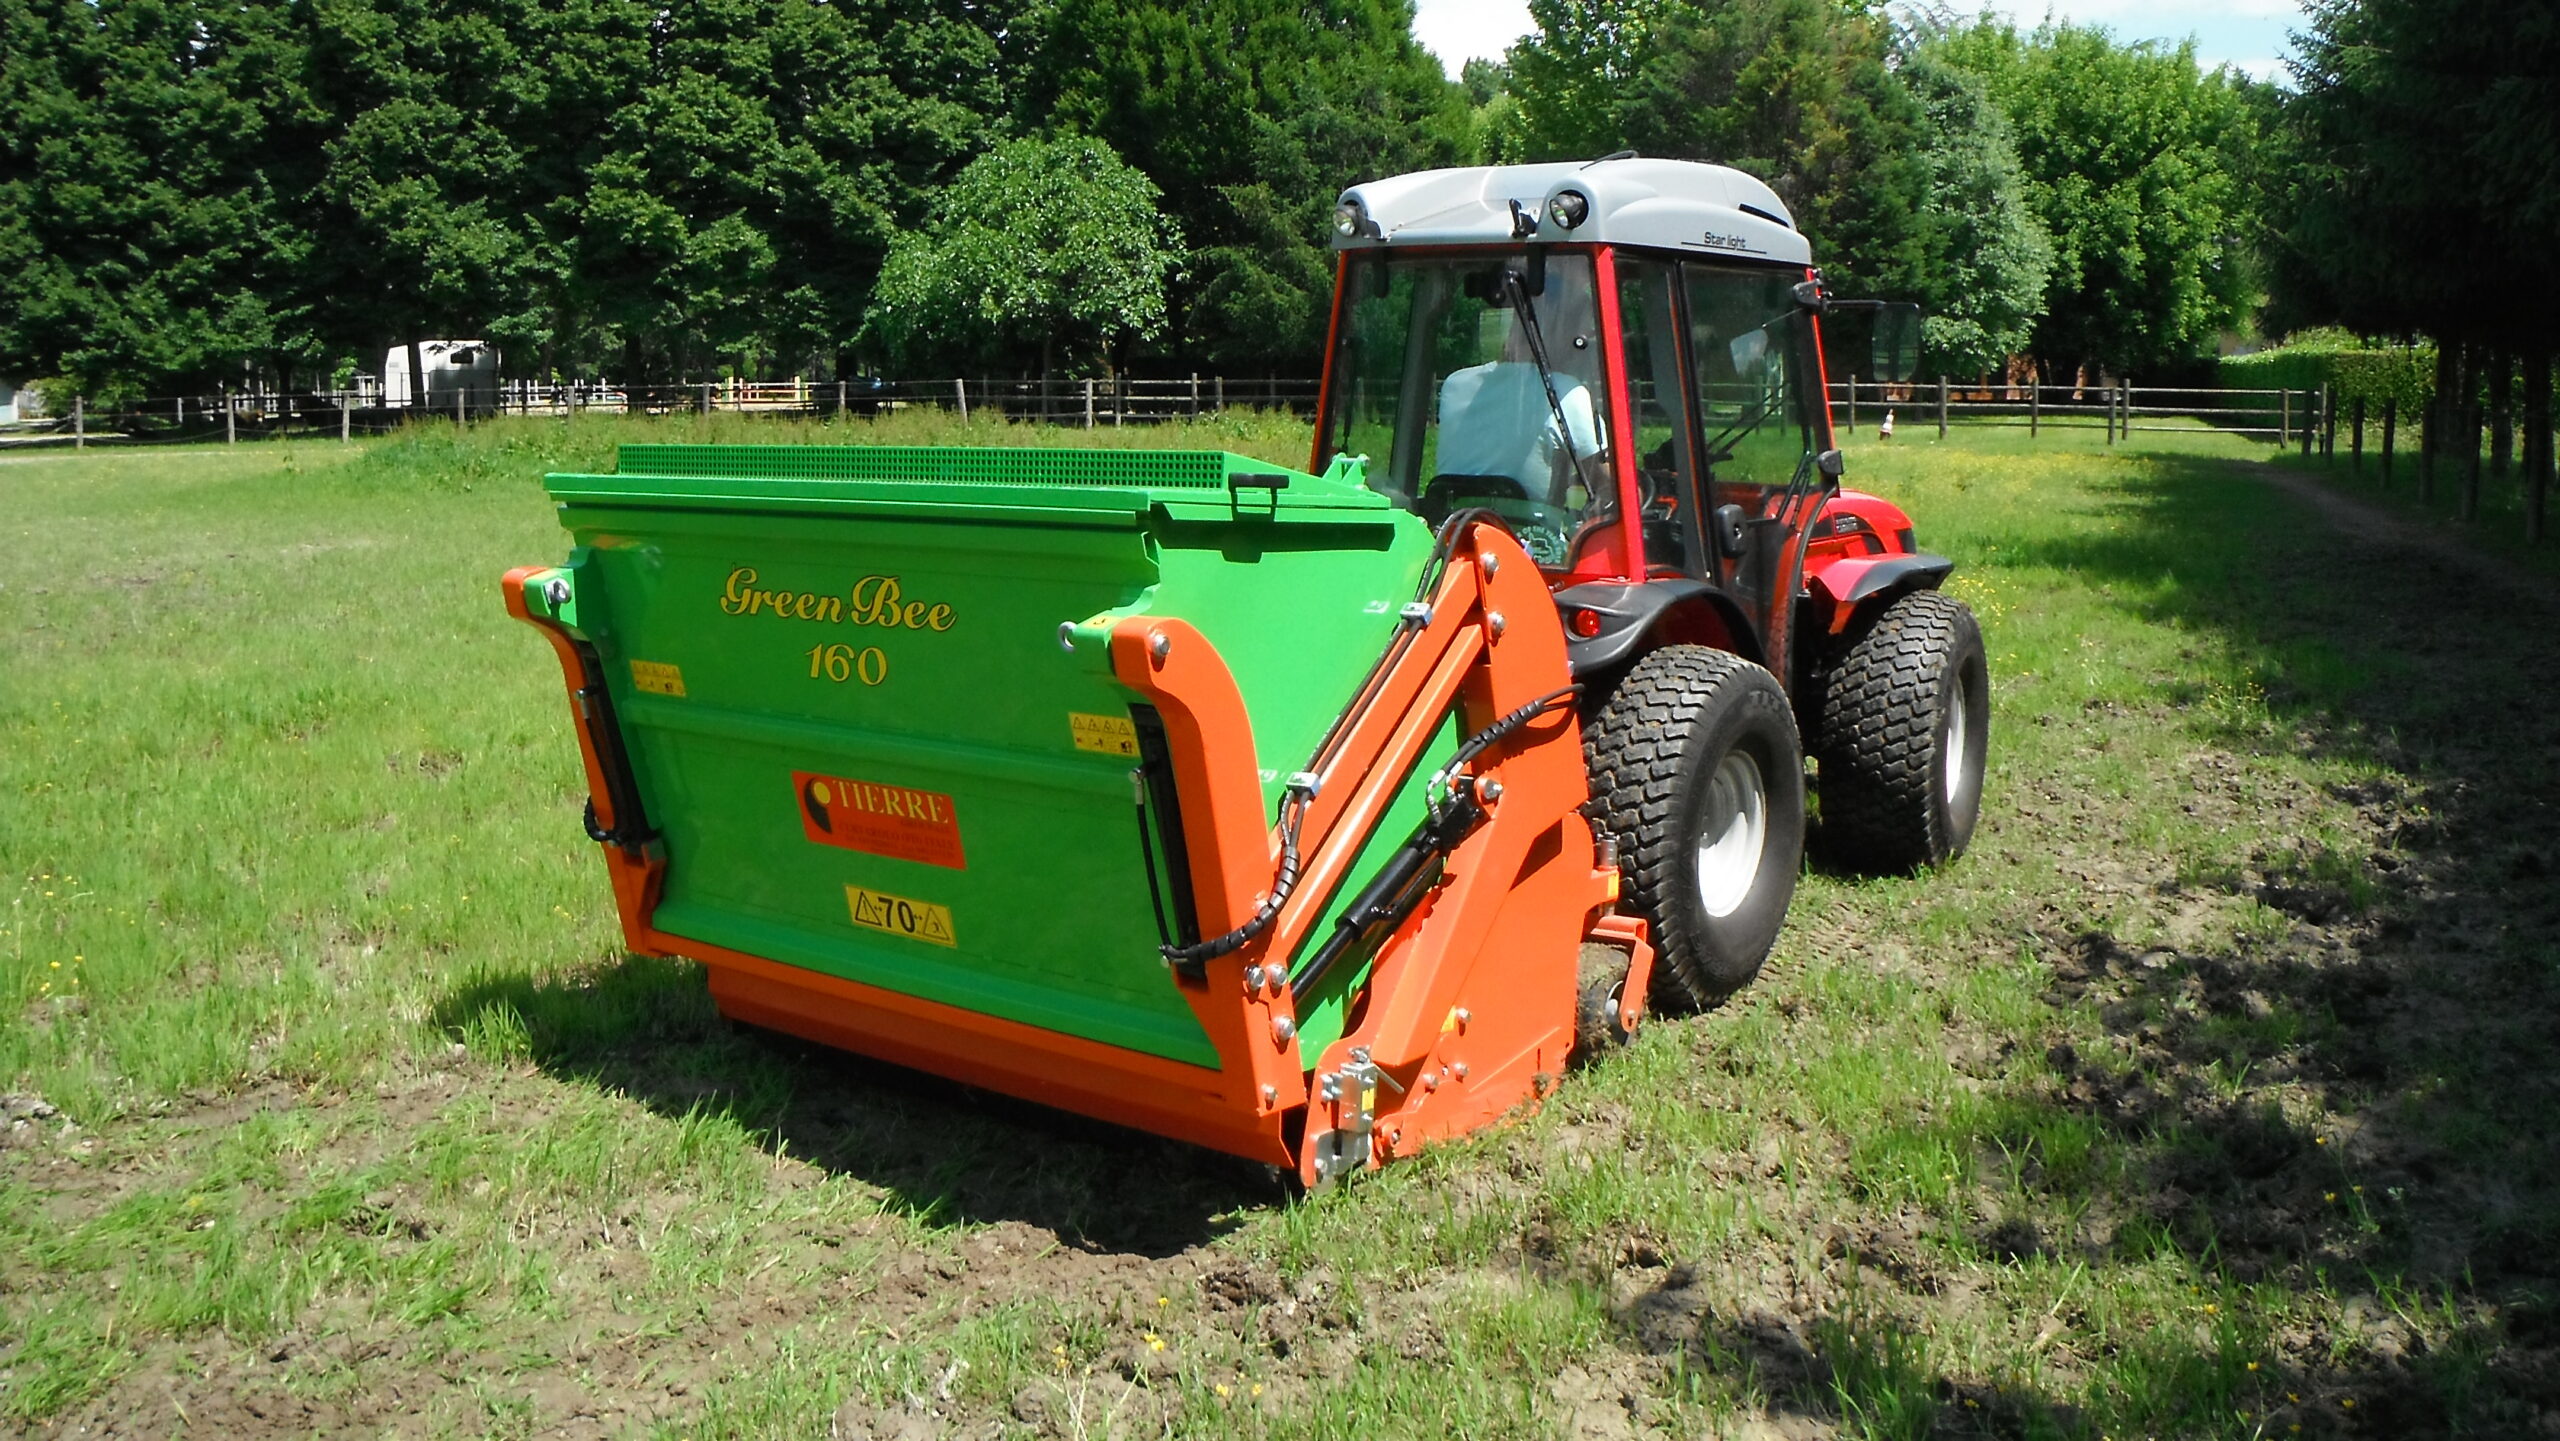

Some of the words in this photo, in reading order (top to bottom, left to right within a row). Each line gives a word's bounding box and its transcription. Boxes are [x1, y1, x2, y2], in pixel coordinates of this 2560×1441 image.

[1704, 231, 1725, 245] Star
[1727, 234, 1746, 251] light
[720, 566, 850, 623] Green
[851, 575, 957, 632] Bee
[805, 643, 888, 686] 160
[832, 780, 949, 824] TIERRE
[878, 896, 915, 933] 70
